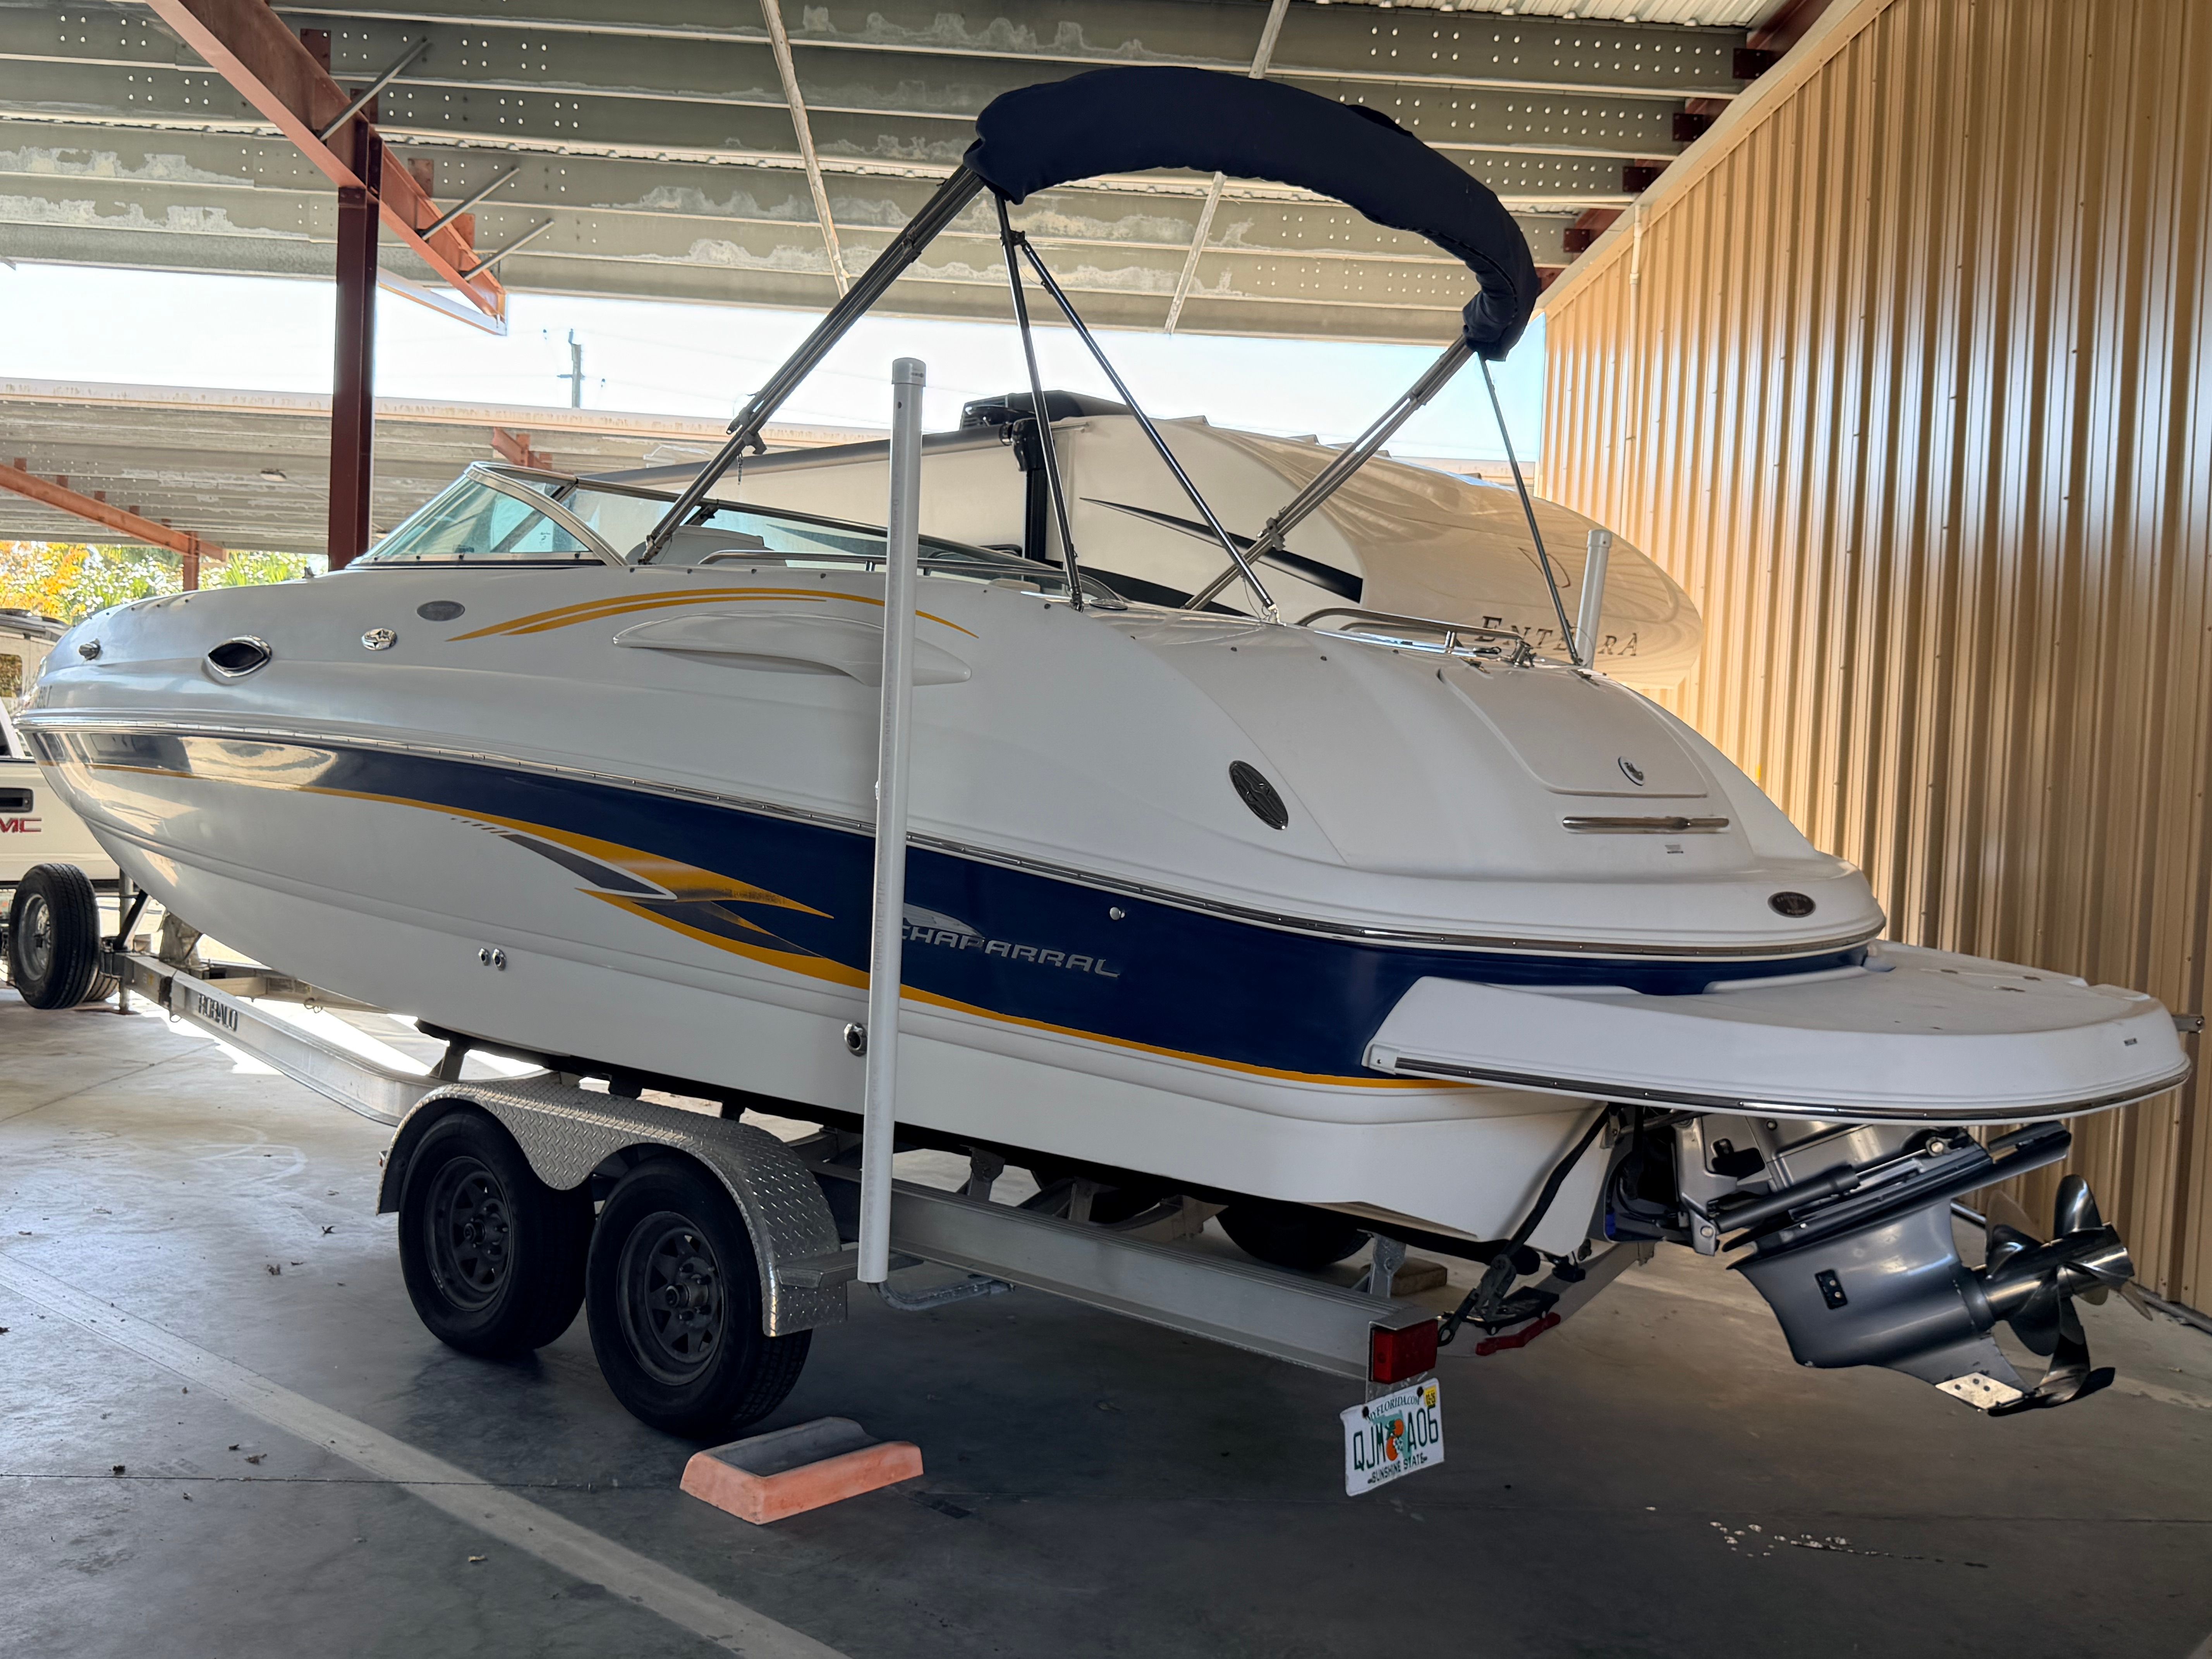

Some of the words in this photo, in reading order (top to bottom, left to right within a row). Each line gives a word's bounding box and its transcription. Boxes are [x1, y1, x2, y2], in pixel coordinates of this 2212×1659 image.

[0, 817, 42, 833] MC
[1353, 1421, 1386, 1471] QJM
[1372, 1460, 1401, 1483] SUNSHINE
[1403, 1453, 1424, 1470] STATE
